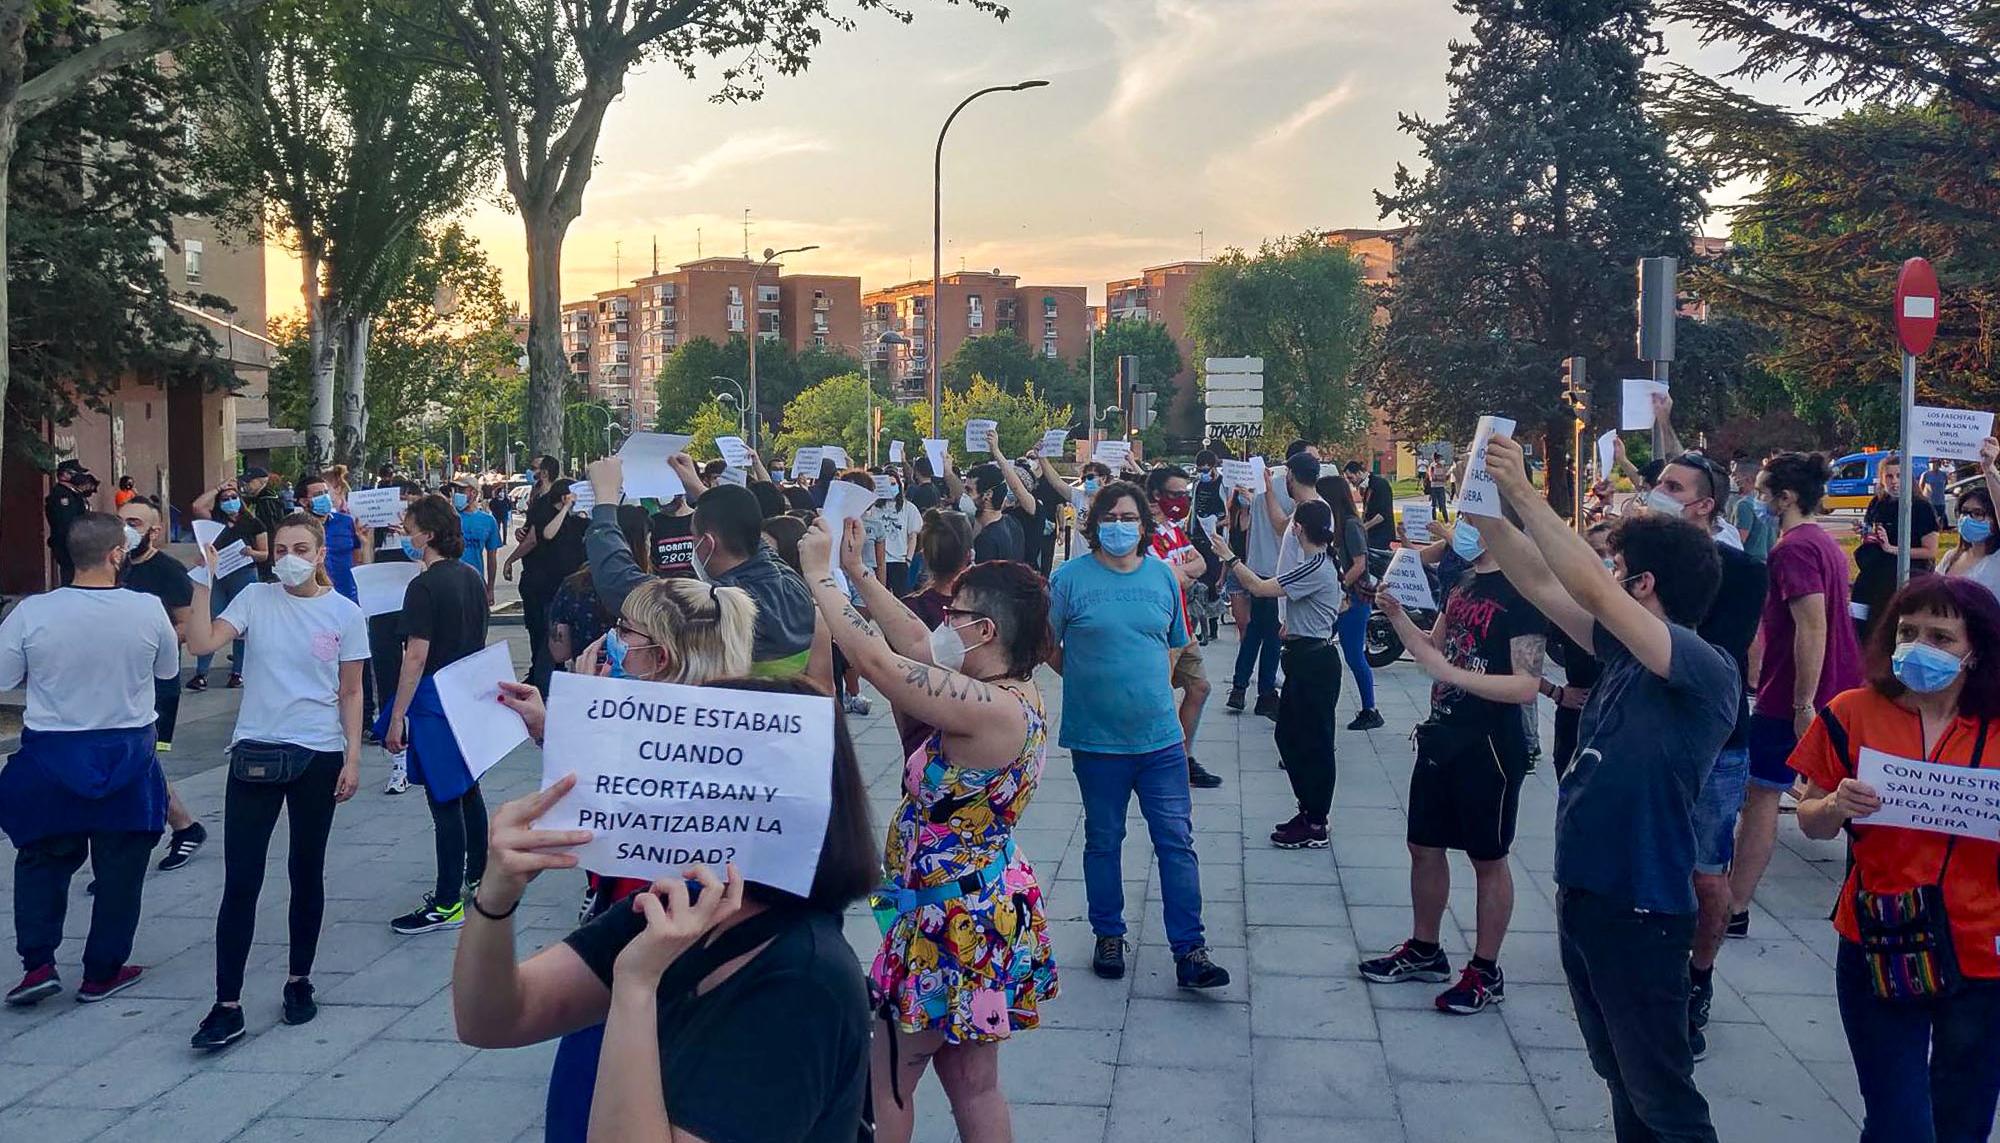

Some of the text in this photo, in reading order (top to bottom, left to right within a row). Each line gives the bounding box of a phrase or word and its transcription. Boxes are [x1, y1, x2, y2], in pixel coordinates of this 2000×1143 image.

[659, 541, 693, 553] MORATA
[661, 552, 693, 564] 2803
[587, 696, 802, 733] ¿DÓNDE ESTABAIS
[639, 740, 743, 766] CUANDO
[1882, 763, 2000, 791] CON NUESTR
[595, 775, 779, 803] RECORTABAN Y
[1887, 782, 1945, 798] SALUD
[1951, 791, 1979, 803] NO
[578, 809, 782, 835] PRIVATIZABAN LA
[1911, 814, 1968, 830] FUERA
[1942, 804, 2000, 821] FACHA
[616, 843, 736, 865] SANIDAD?
